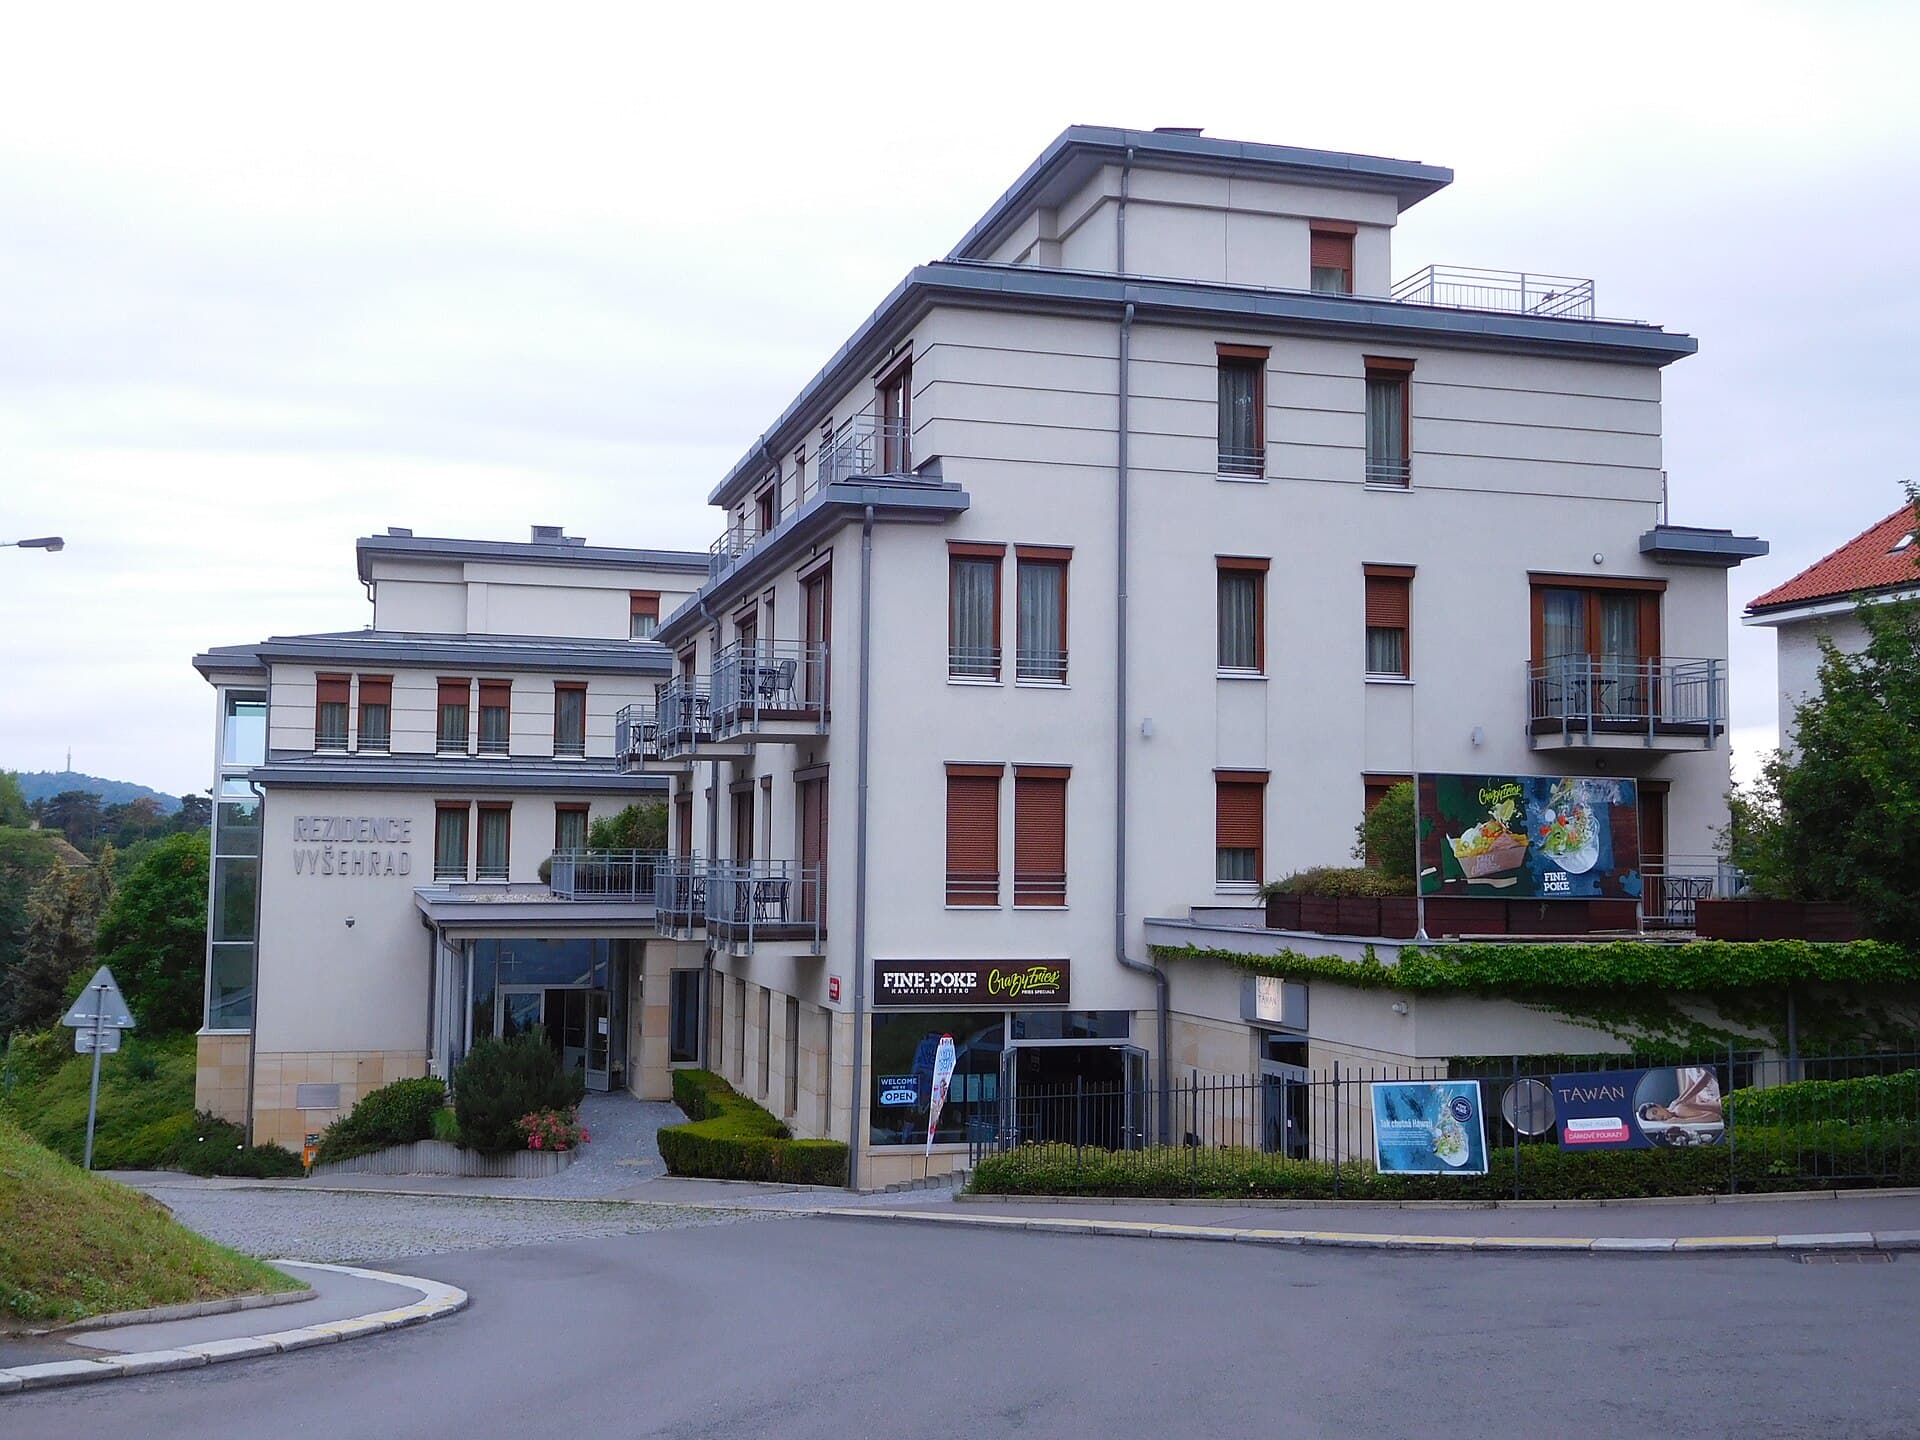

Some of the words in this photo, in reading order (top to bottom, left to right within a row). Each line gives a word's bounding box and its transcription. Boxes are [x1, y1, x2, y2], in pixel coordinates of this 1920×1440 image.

[294, 816, 413, 843] REZIDENCE
[294, 845, 411, 876] VYŠEHRAD
[1544, 872, 1567, 881] FINE
[1544, 882, 1570, 891] POKE
[885, 1092, 913, 1101] OPEN
[1559, 1086, 1625, 1103] TAWAN
